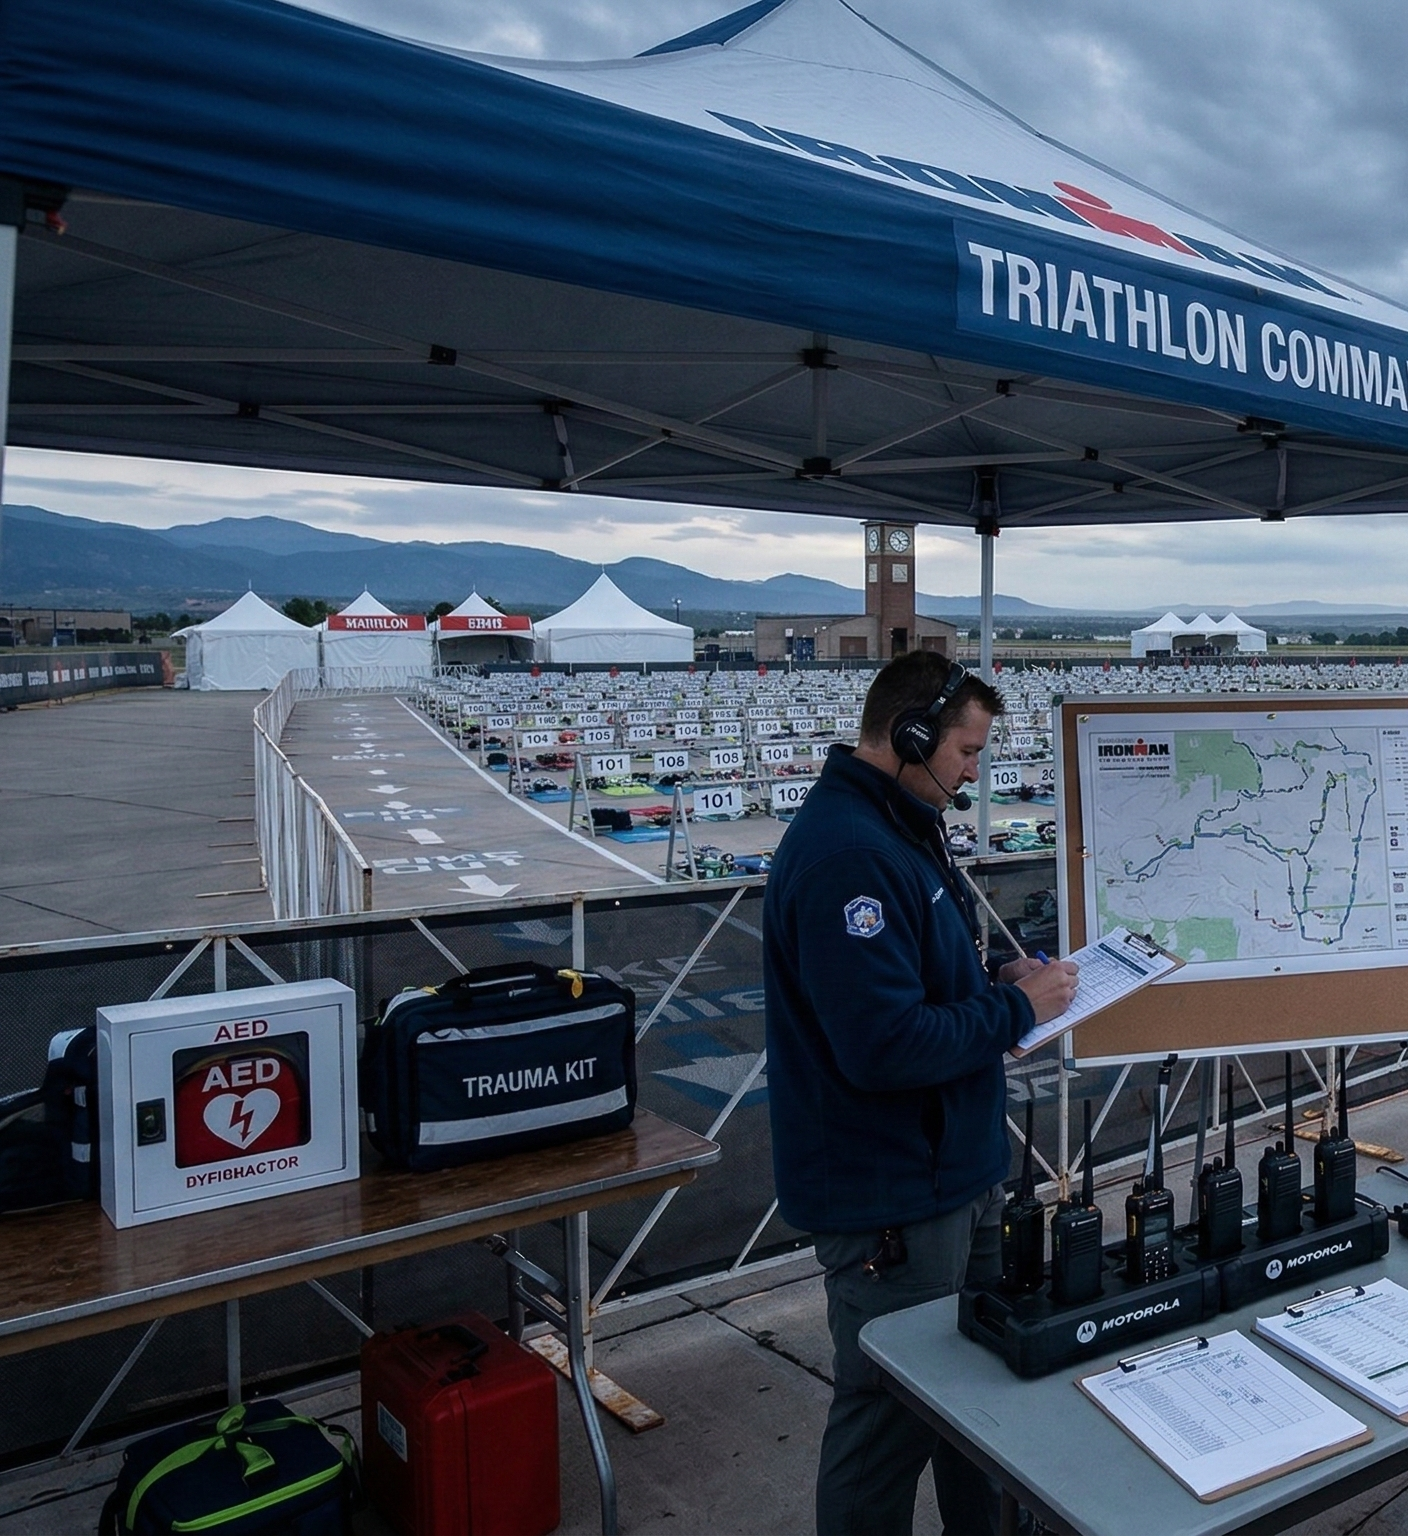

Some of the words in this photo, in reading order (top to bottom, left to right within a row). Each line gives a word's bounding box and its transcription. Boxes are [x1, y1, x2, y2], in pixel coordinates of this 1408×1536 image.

[967, 242, 1247, 374] TRIATHLON
[589, 731, 610, 741] 105
[633, 729, 653, 738] 104
[679, 727, 698, 735] 104
[527, 735, 548, 744] 104
[1097, 742, 1170, 757] IRONMAN
[597, 759, 623, 771] 101
[659, 756, 685, 768] 108
[994, 771, 1018, 785] 103
[701, 792, 733, 809] 101
[778, 786, 809, 802] 102
[214, 1020, 269, 1042] AED
[202, 1058, 280, 1093] AED
[462, 1065, 559, 1098] TRAUMA
[565, 1057, 598, 1083] KIT
[1286, 1240, 1353, 1269] MOTOROLA
[1101, 1298, 1180, 1331] MOTOROLA
